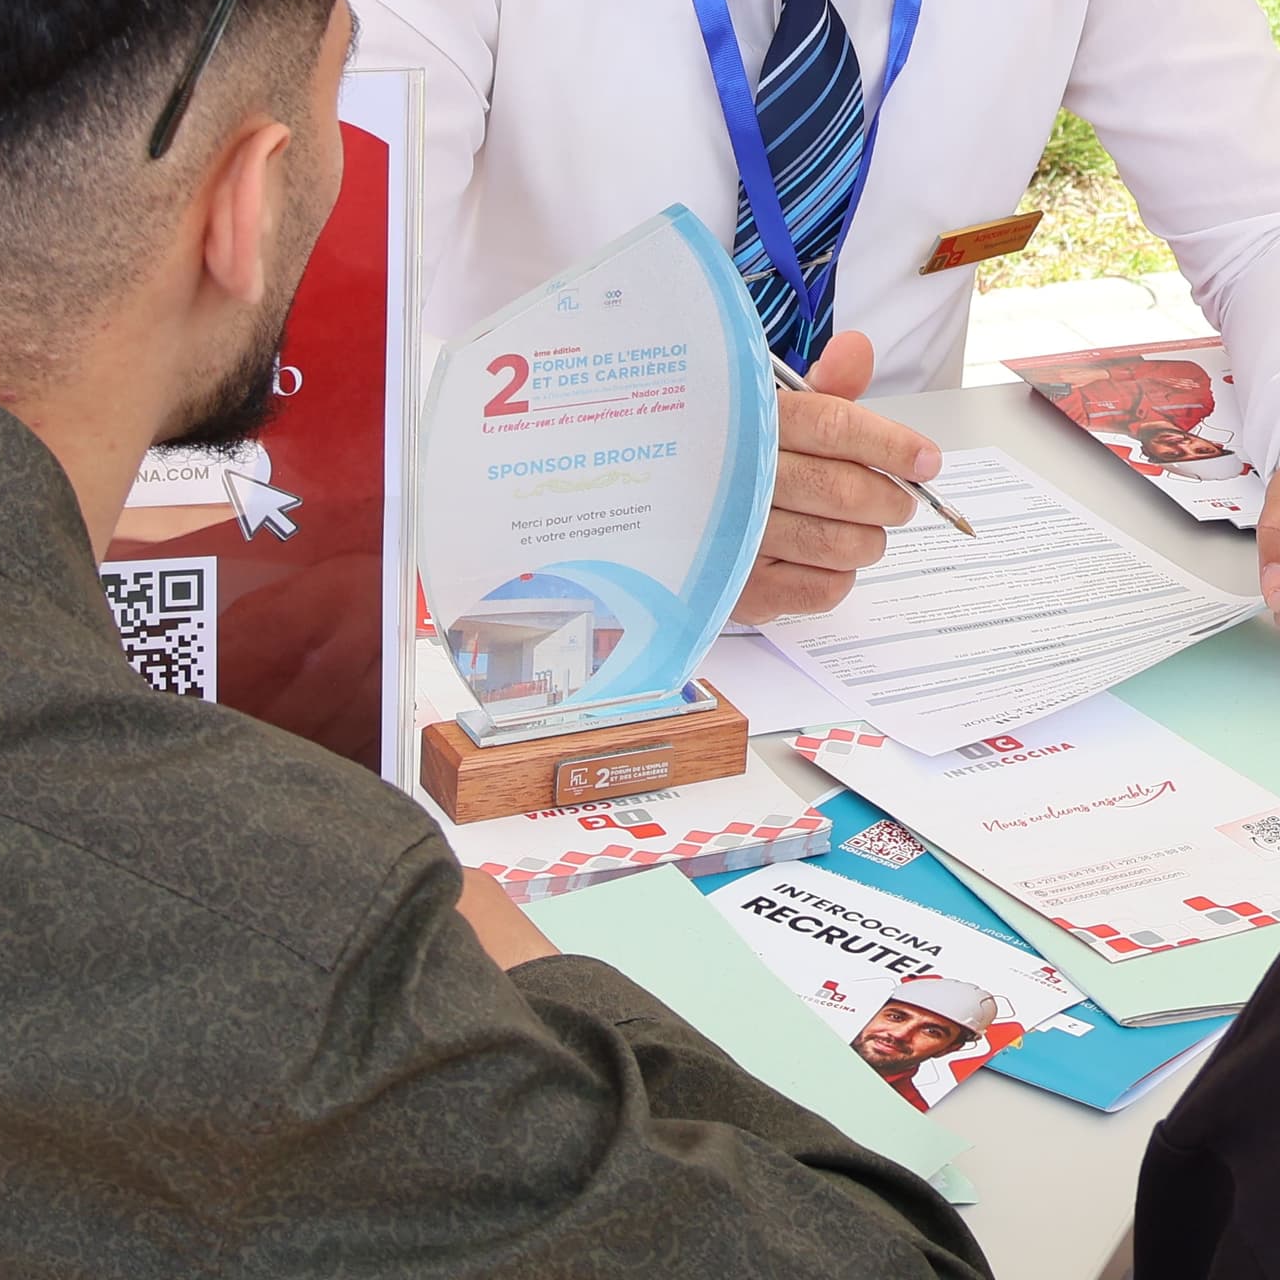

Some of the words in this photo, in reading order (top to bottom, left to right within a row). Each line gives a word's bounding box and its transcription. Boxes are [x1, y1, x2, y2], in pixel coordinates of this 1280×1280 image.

[533, 356, 588, 373] FORUM
[593, 353, 613, 366] DE
[618, 343, 687, 363] L'EMPLOI
[484, 354, 529, 417] 2
[533, 376, 552, 389] ET
[558, 372, 589, 386] DES
[595, 360, 687, 381] CARRIÈRES
[632, 389, 660, 399] Nador
[662, 385, 686, 395] 2026
[483, 423, 495, 433] Le
[498, 419, 555, 432] rendez-vous
[559, 414, 575, 424] des
[577, 408, 633, 423] compétences
[637, 403, 648, 414] de
[651, 400, 685, 413] demain
[136, 466, 210, 483] NA.COM
[487, 454, 587, 480] SPONSOR
[593, 442, 677, 467] BRONZE
[511, 518, 543, 531] Merci
[546, 515, 573, 527] pour
[577, 510, 606, 522] votre
[609, 504, 652, 517] soutien
[520, 535, 532, 545] et
[536, 531, 566, 543] votre
[569, 520, 641, 540] engagement
[943, 740, 1076, 779] INTERCOCINA
[595, 768, 609, 788] 2
[524, 790, 681, 820] INTERCOCINA
[982, 819, 1027, 832] Nous
[1091, 784, 1154, 807] ensemble
[838, 844, 901, 870] INSCRIPTION
[773, 882, 944, 957] INTERCOCINA
[741, 896, 934, 978] RECRUTE!
